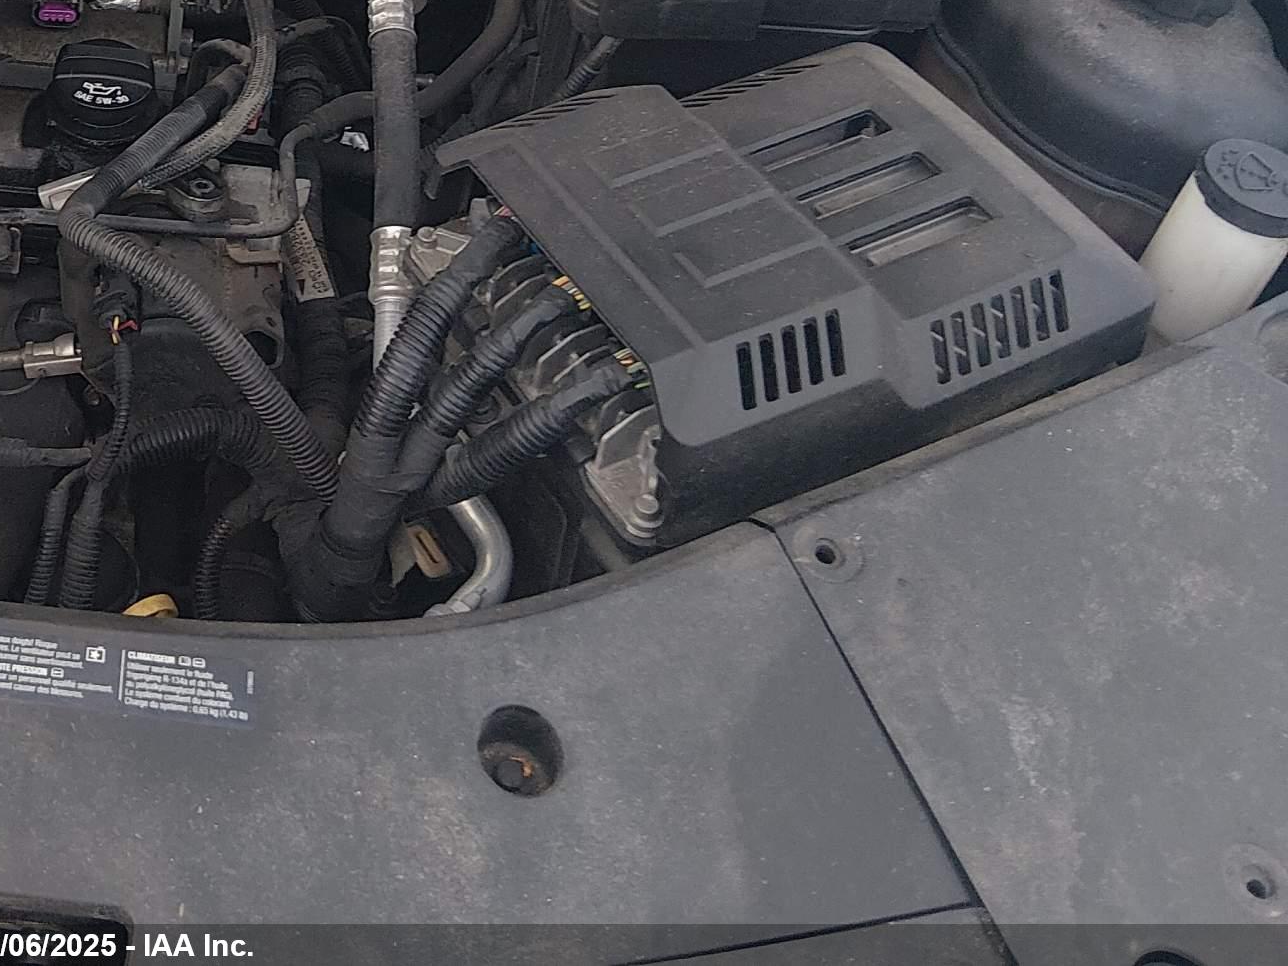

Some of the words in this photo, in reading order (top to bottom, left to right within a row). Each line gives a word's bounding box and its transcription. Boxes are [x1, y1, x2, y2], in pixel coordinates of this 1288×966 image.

[74, 90, 94, 103] SAE
[95, 94, 130, 105] 5W-30
[127, 651, 176, 664] CLIMATISEUR
